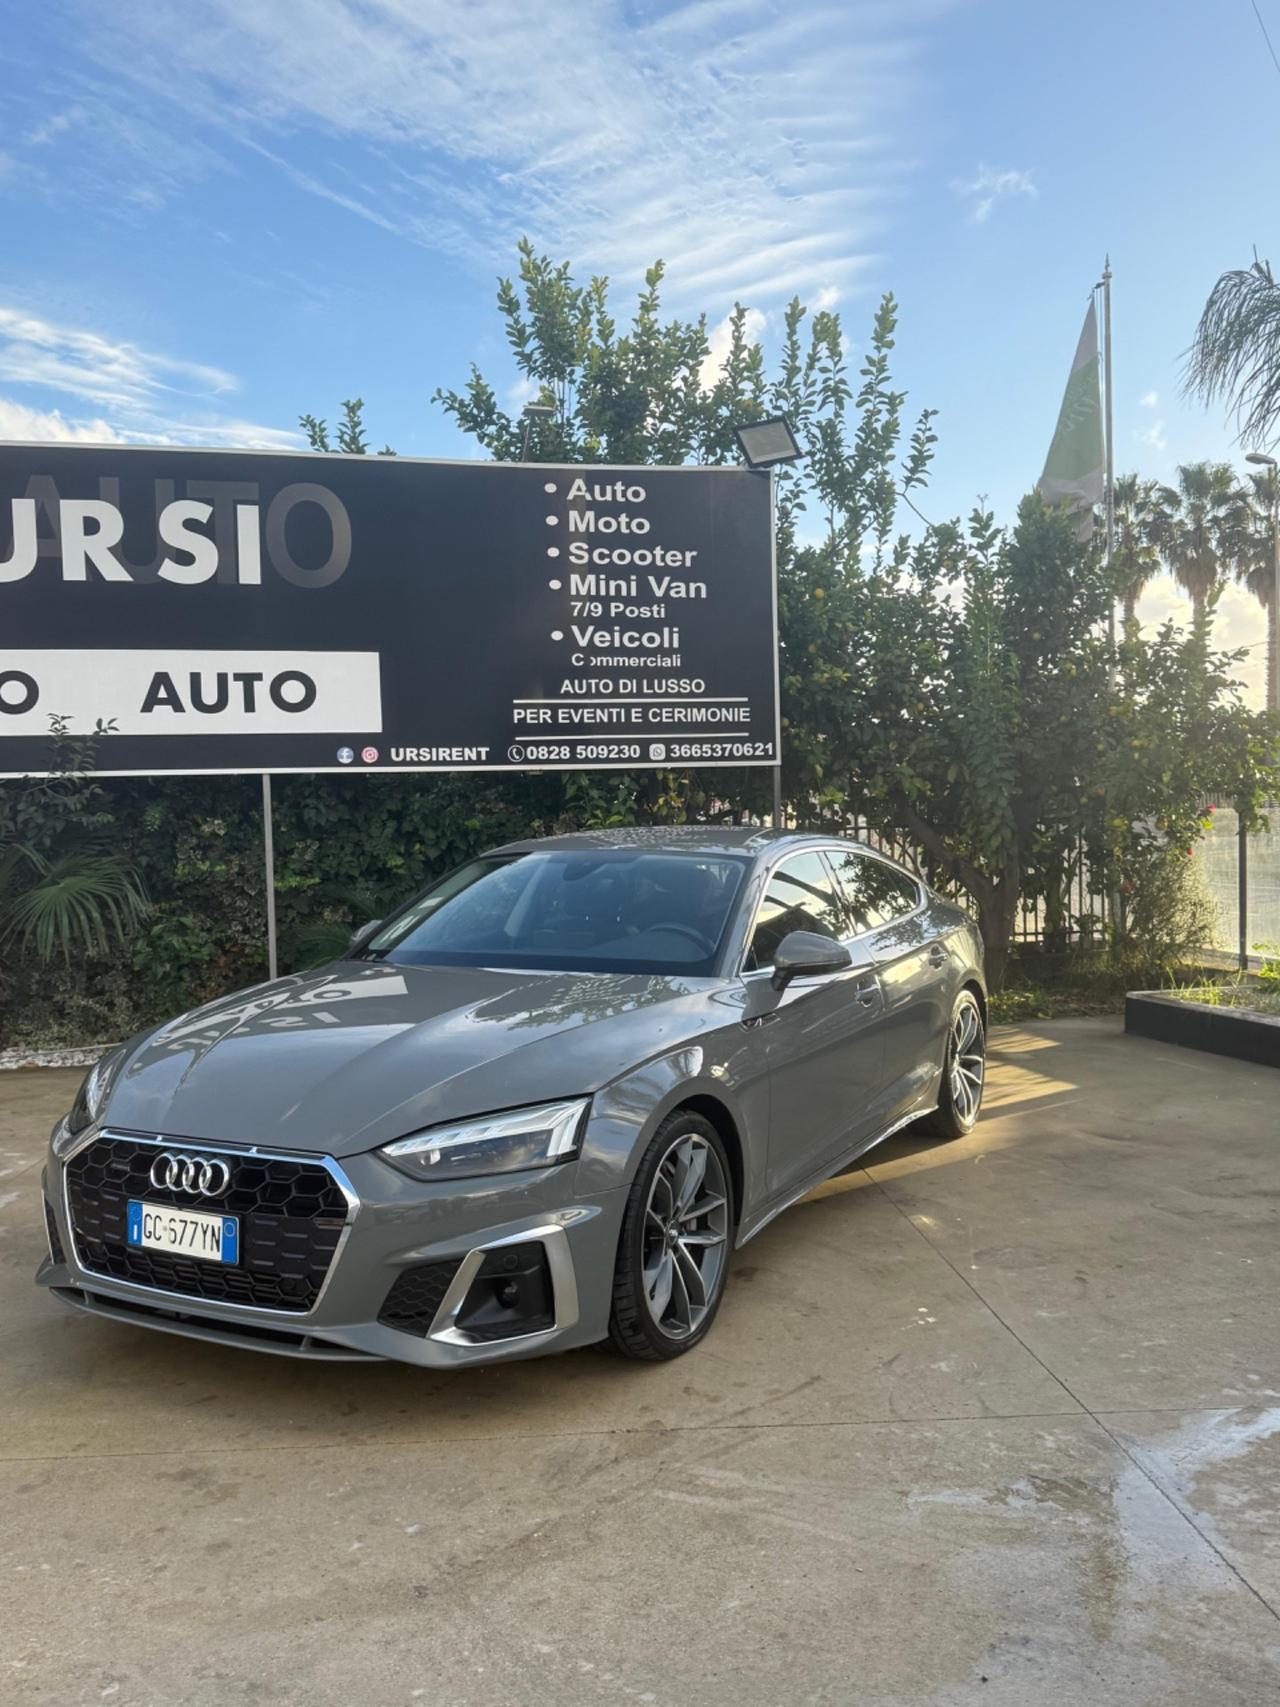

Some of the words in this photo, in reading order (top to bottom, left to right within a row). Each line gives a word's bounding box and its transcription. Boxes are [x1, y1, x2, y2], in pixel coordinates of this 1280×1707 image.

[566, 478, 647, 502] Auto
[568, 510, 651, 534] Moto
[568, 541, 697, 567] Scooter
[570, 573, 638, 596] Mini
[647, 575, 707, 598] Van
[570, 601, 602, 617] 7/9
[610, 602, 666, 618] Posti
[571, 624, 680, 648] Veicoli
[140, 670, 317, 714] AUTO
[560, 680, 613, 694] AUTO
[619, 680, 637, 694] DI
[643, 679, 706, 693] LUSSO
[513, 709, 552, 724] PER
[558, 708, 626, 723] EVENTI
[631, 708, 643, 722] E
[648, 707, 751, 723] CERIMONIE
[390, 747, 490, 761] URSIRENT
[526, 746, 570, 760] 0828
[576, 745, 641, 759] 509230
[670, 743, 774, 758] 3665370621
